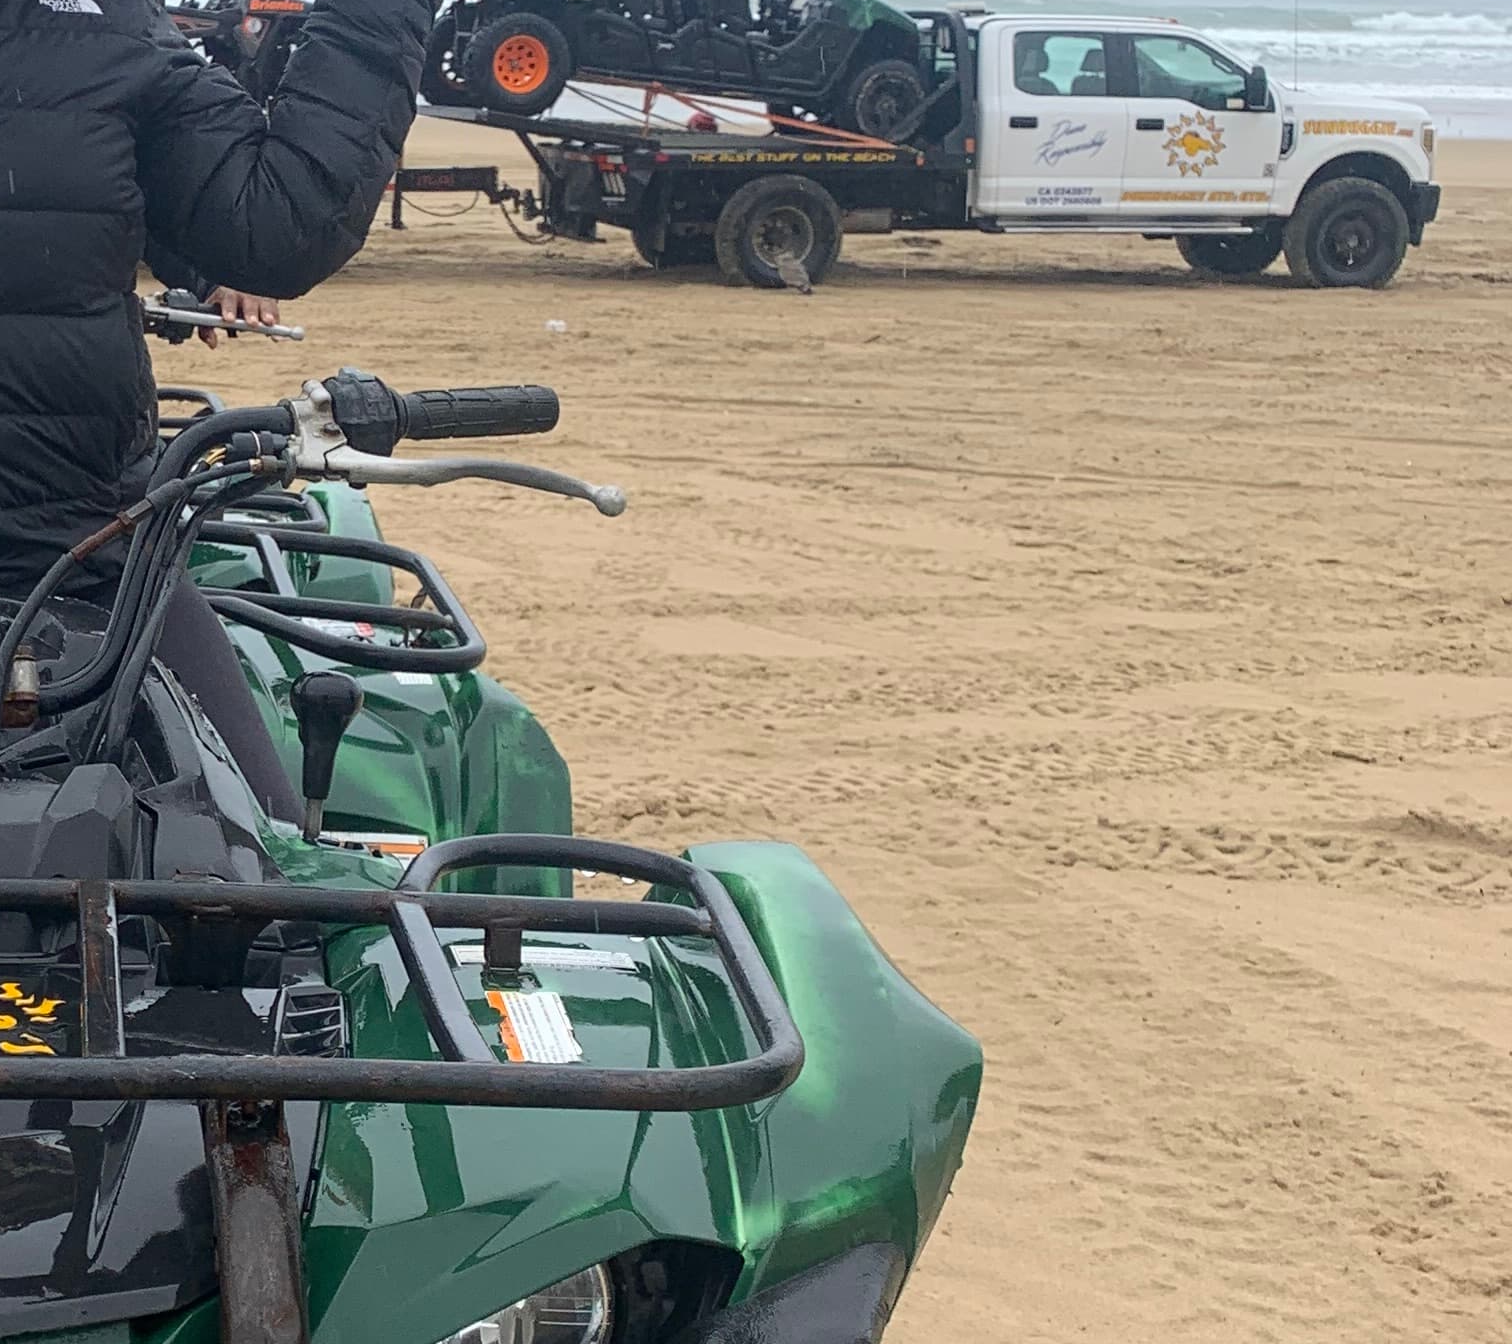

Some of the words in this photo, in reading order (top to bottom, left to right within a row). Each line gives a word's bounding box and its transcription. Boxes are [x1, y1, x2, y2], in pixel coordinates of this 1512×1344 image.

[691, 152, 716, 162] THE
[719, 152, 752, 163] BEST
[756, 152, 800, 163] STUFF
[803, 152, 822, 162] ON
[825, 152, 850, 163] THE
[852, 152, 897, 163] BEACH
